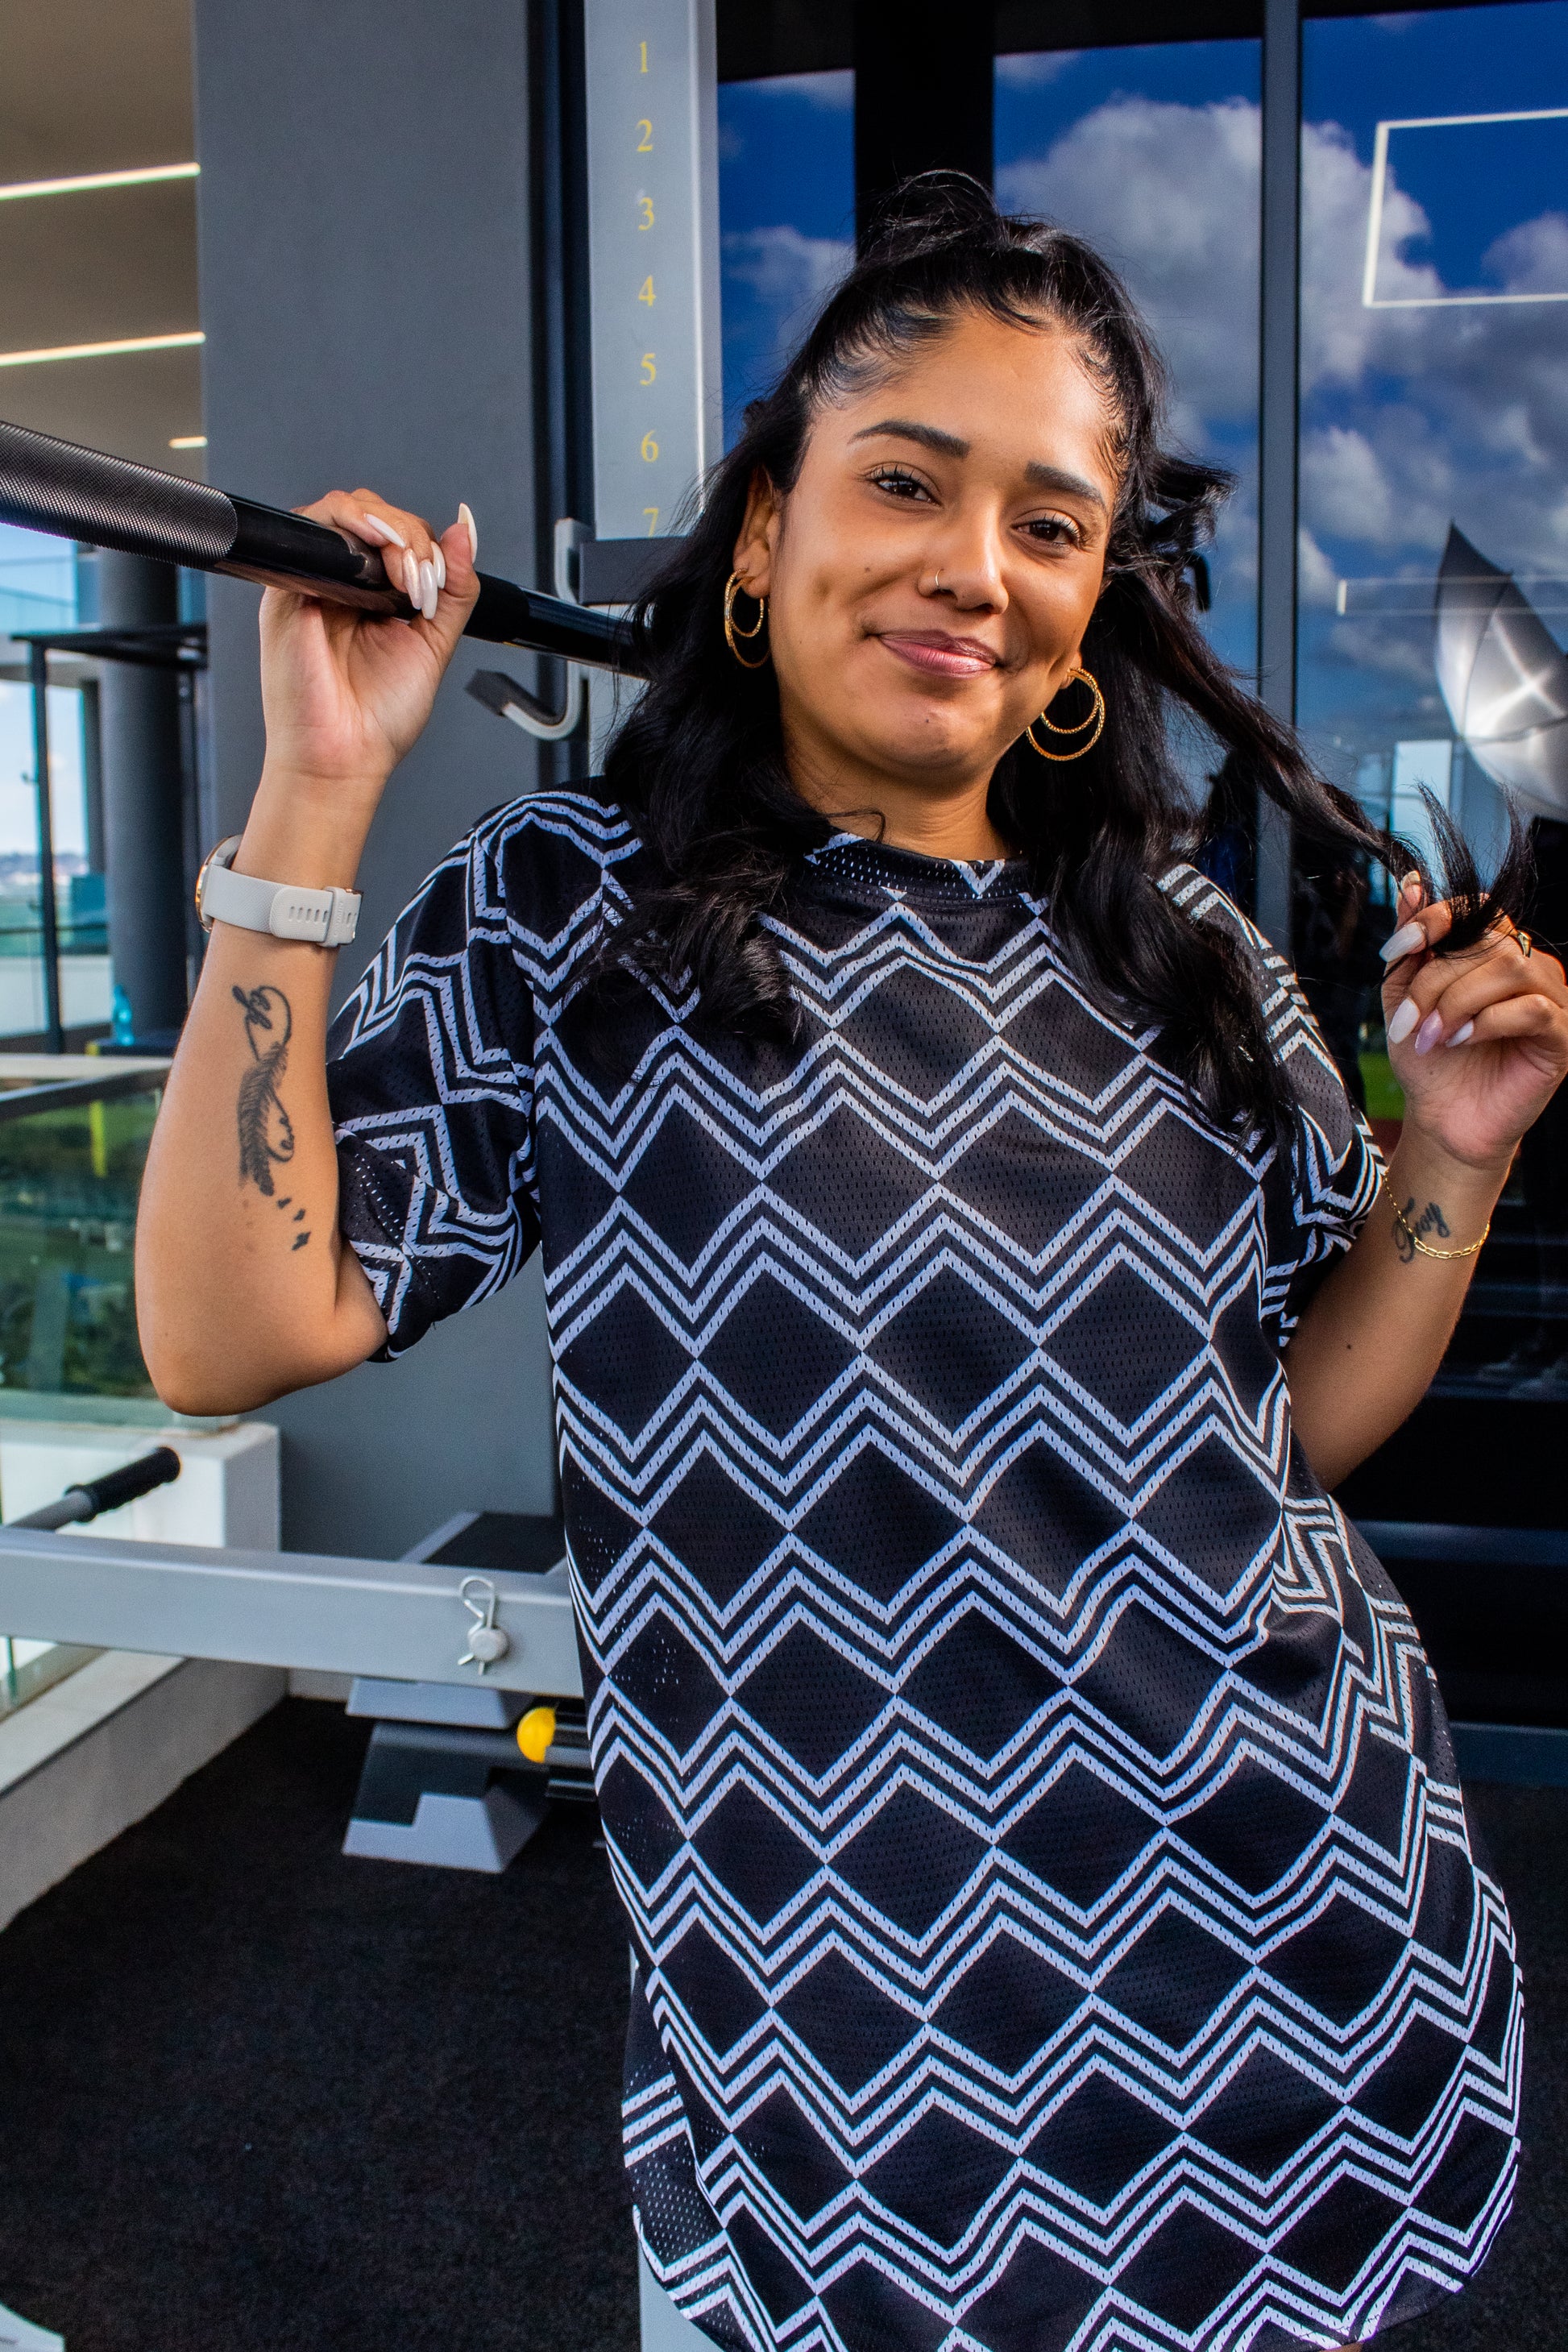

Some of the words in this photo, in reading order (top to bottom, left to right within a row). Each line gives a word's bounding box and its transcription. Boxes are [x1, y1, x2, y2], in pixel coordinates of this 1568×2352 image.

[639, 40, 649, 73] 1
[636, 118, 653, 152] 2
[637, 197, 655, 230] 3
[637, 274, 657, 307] 4
[639, 353, 657, 386] 5
[640, 429, 659, 463] 6
[641, 507, 659, 537] 7
